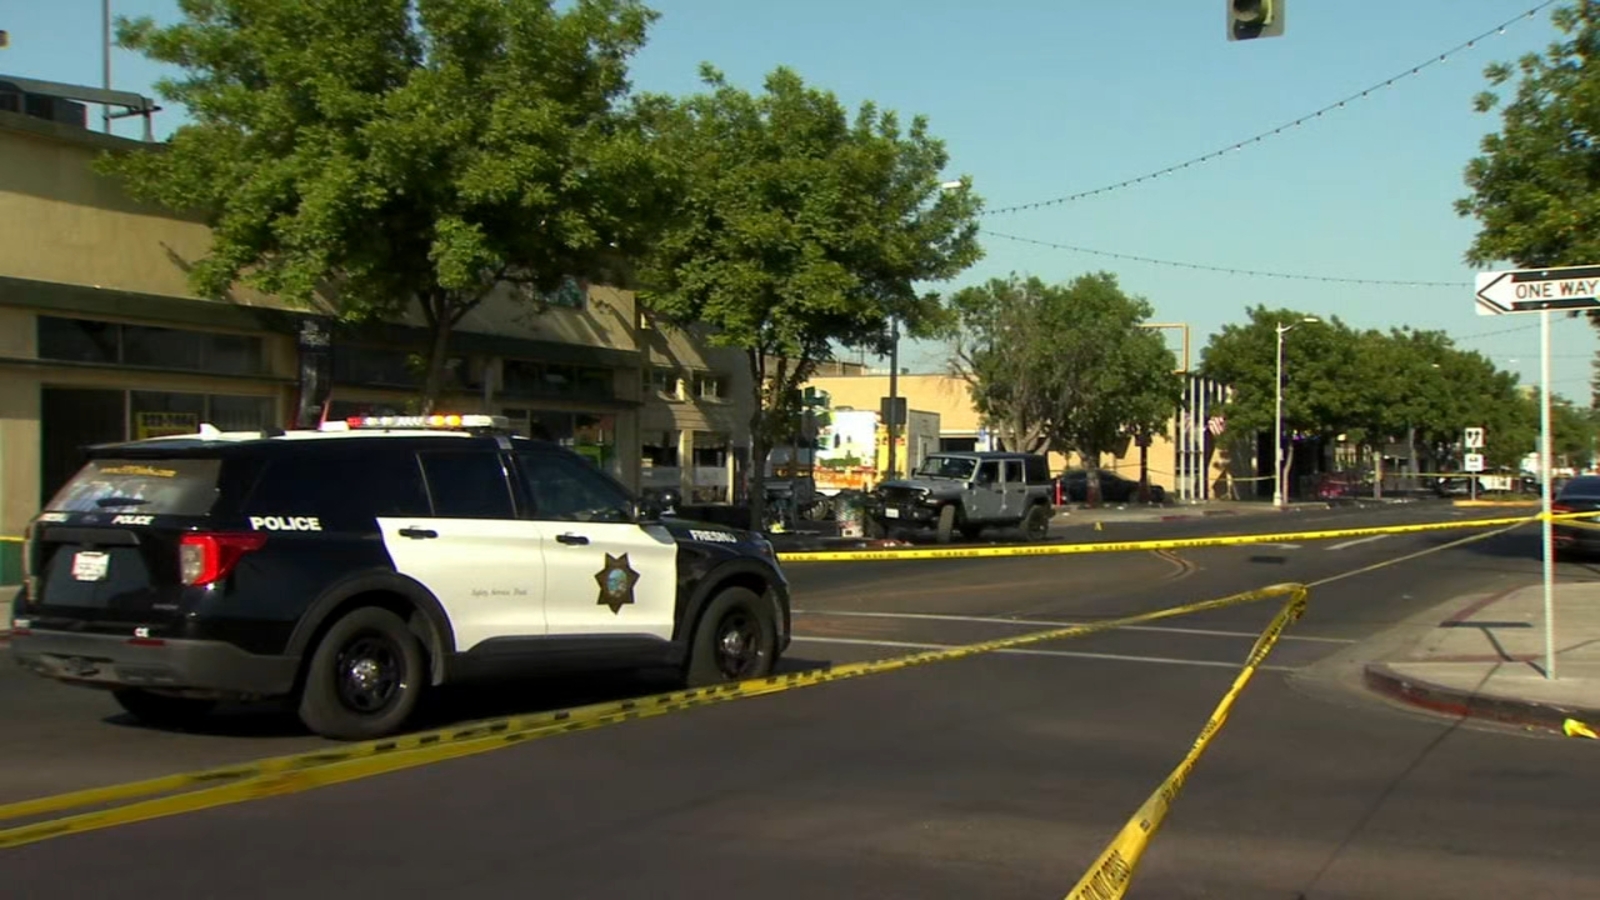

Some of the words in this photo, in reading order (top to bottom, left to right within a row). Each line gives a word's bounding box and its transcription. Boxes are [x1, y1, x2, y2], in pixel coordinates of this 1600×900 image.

[1516, 283, 1553, 298] ONE
[1560, 280, 1598, 296] WAY
[111, 515, 155, 525] POLICE
[250, 516, 322, 531] POLICE
[689, 529, 737, 543] FRESNO
